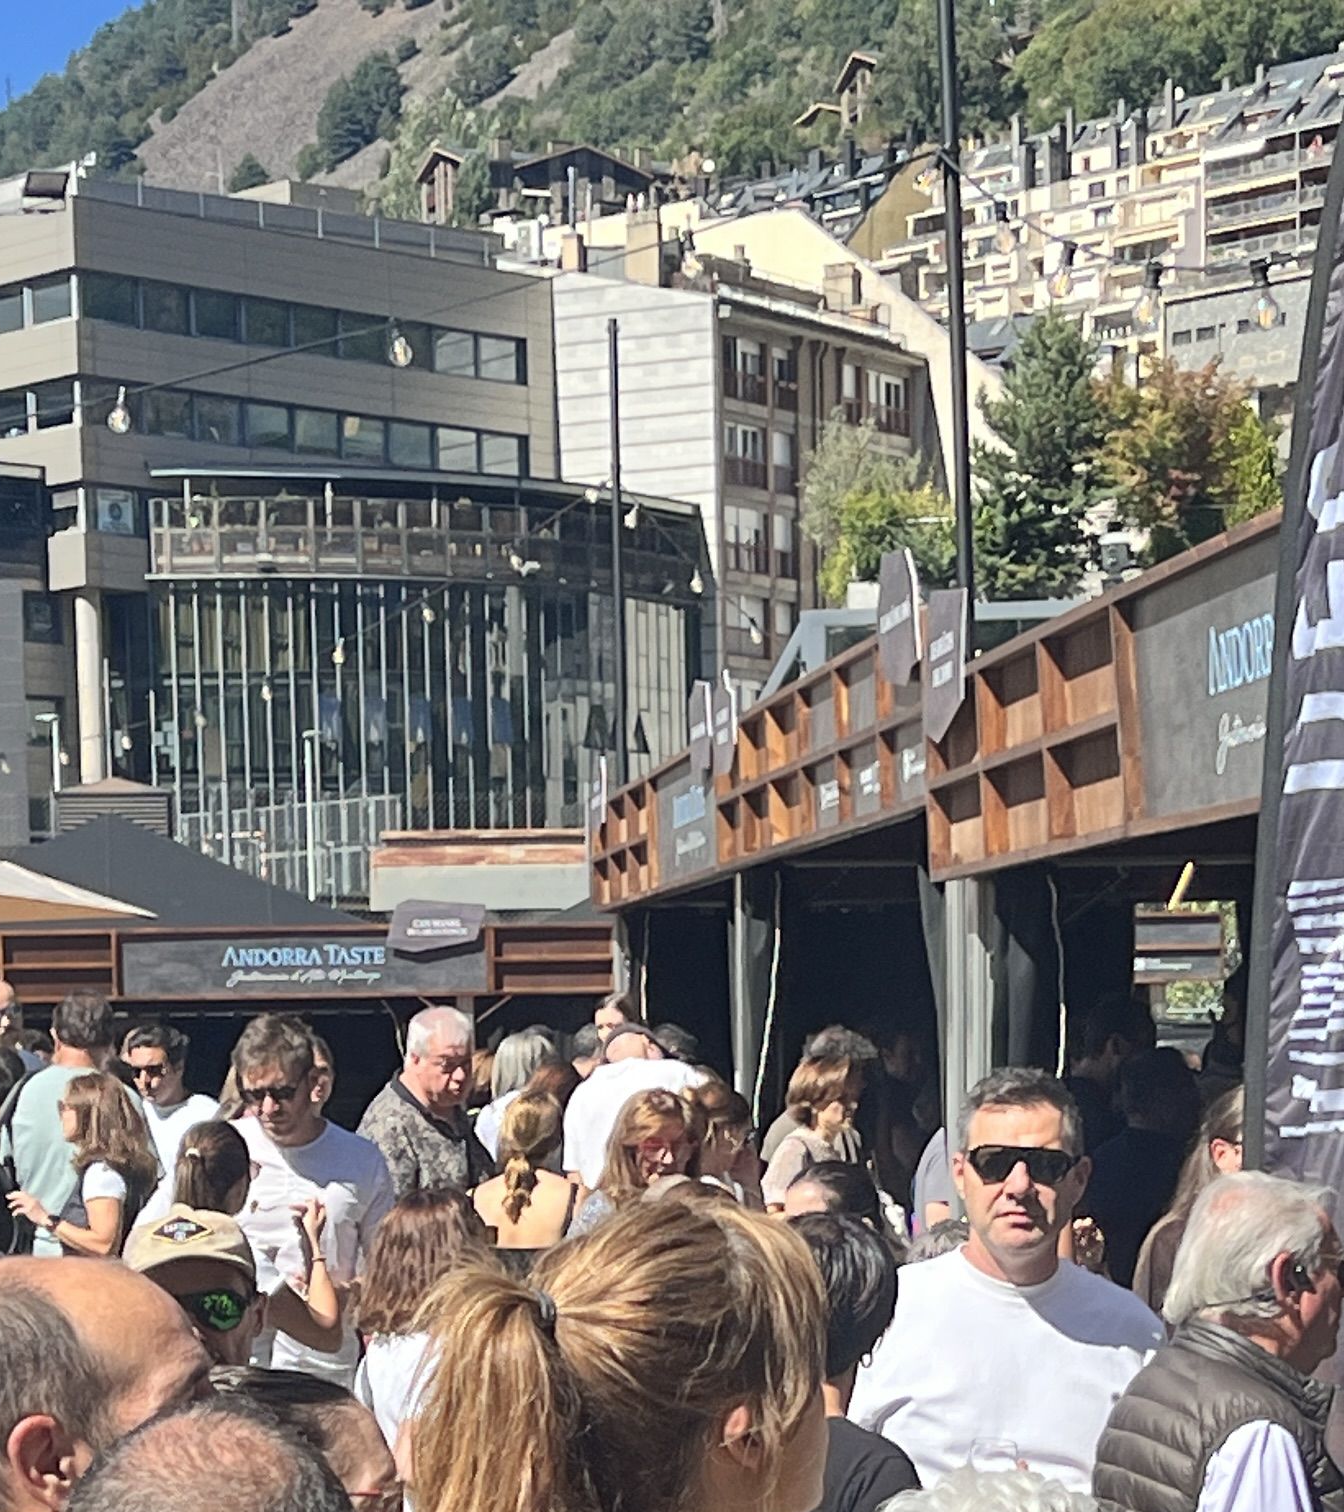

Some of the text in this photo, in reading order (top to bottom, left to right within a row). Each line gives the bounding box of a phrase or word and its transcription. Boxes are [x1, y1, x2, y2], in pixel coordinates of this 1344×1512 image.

[1208, 613, 1275, 696] ANDORR
[221, 944, 386, 967] ANDORRA TASTE
